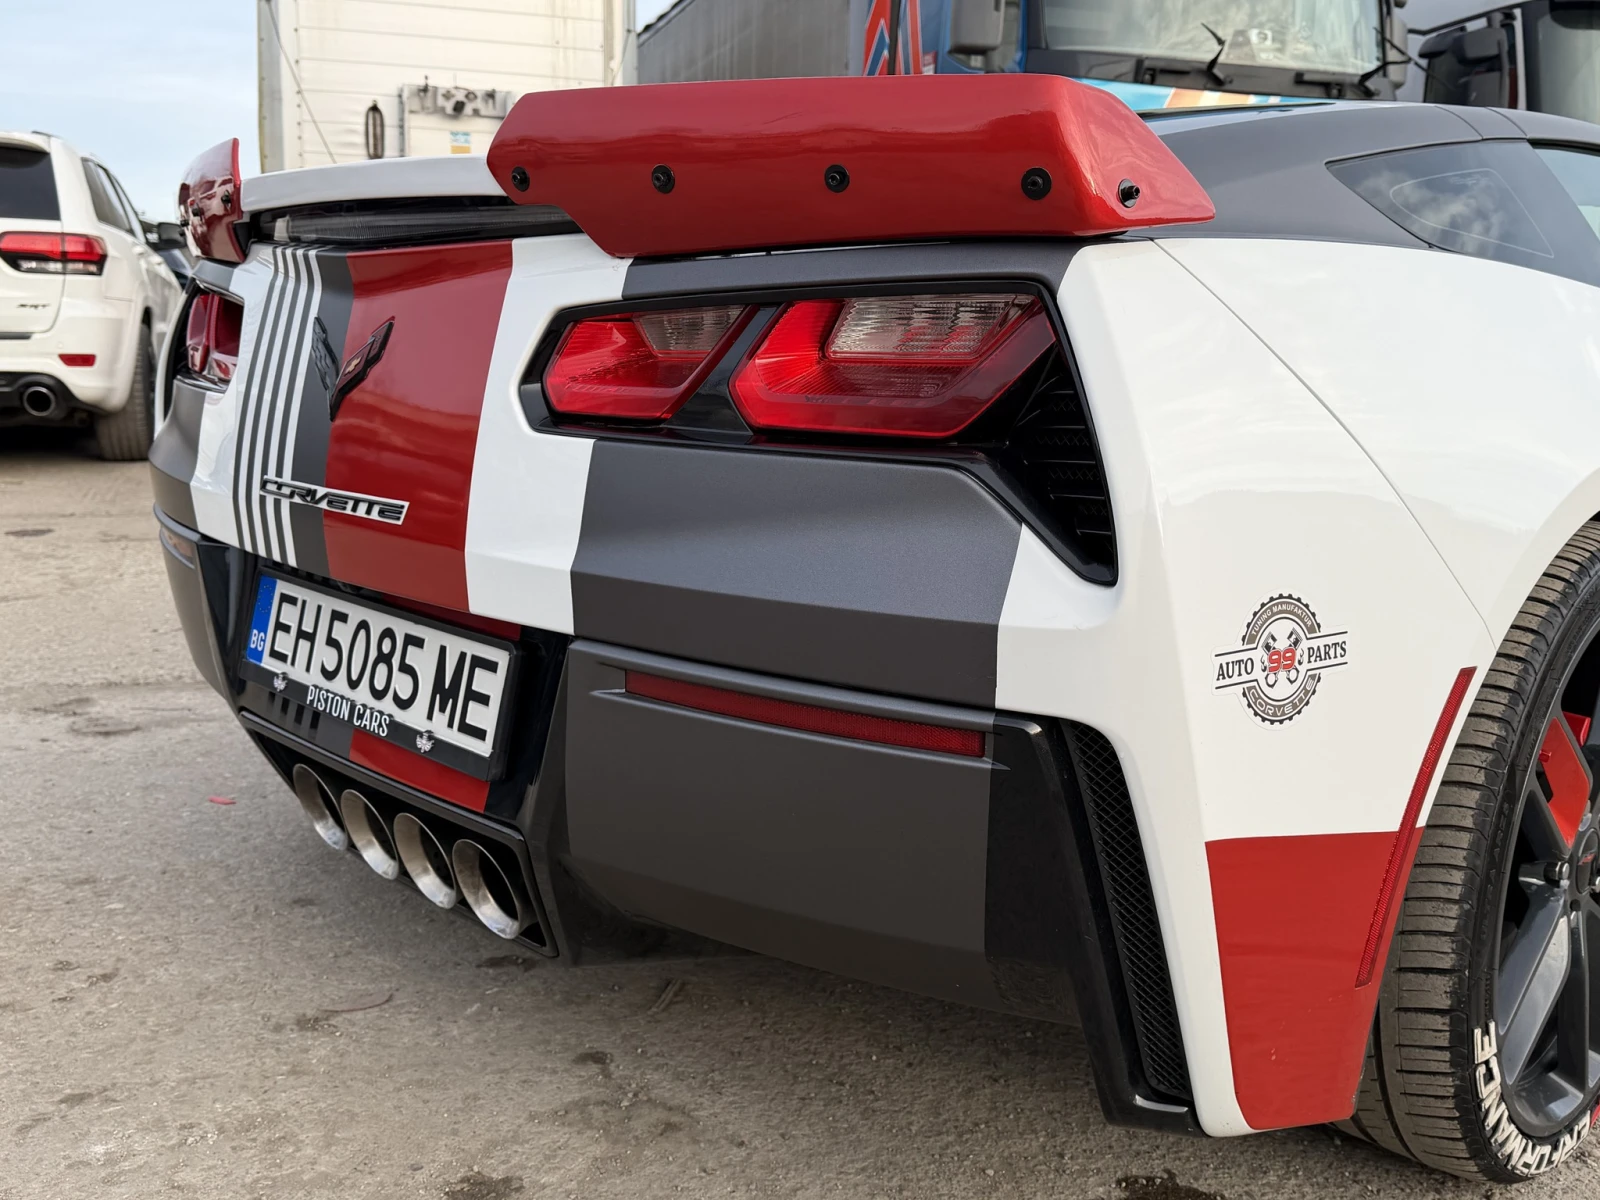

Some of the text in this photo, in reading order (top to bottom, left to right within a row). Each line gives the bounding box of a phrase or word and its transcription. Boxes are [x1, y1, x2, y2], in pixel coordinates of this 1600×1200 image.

[1251, 603, 1312, 635] TUNING MANUFAKTUR
[250, 628, 265, 652] BG
[1216, 640, 1347, 681] AUTO 99 PARTS
[306, 684, 390, 737] PISTON CARS
[1249, 677, 1315, 716] CORVETTE
